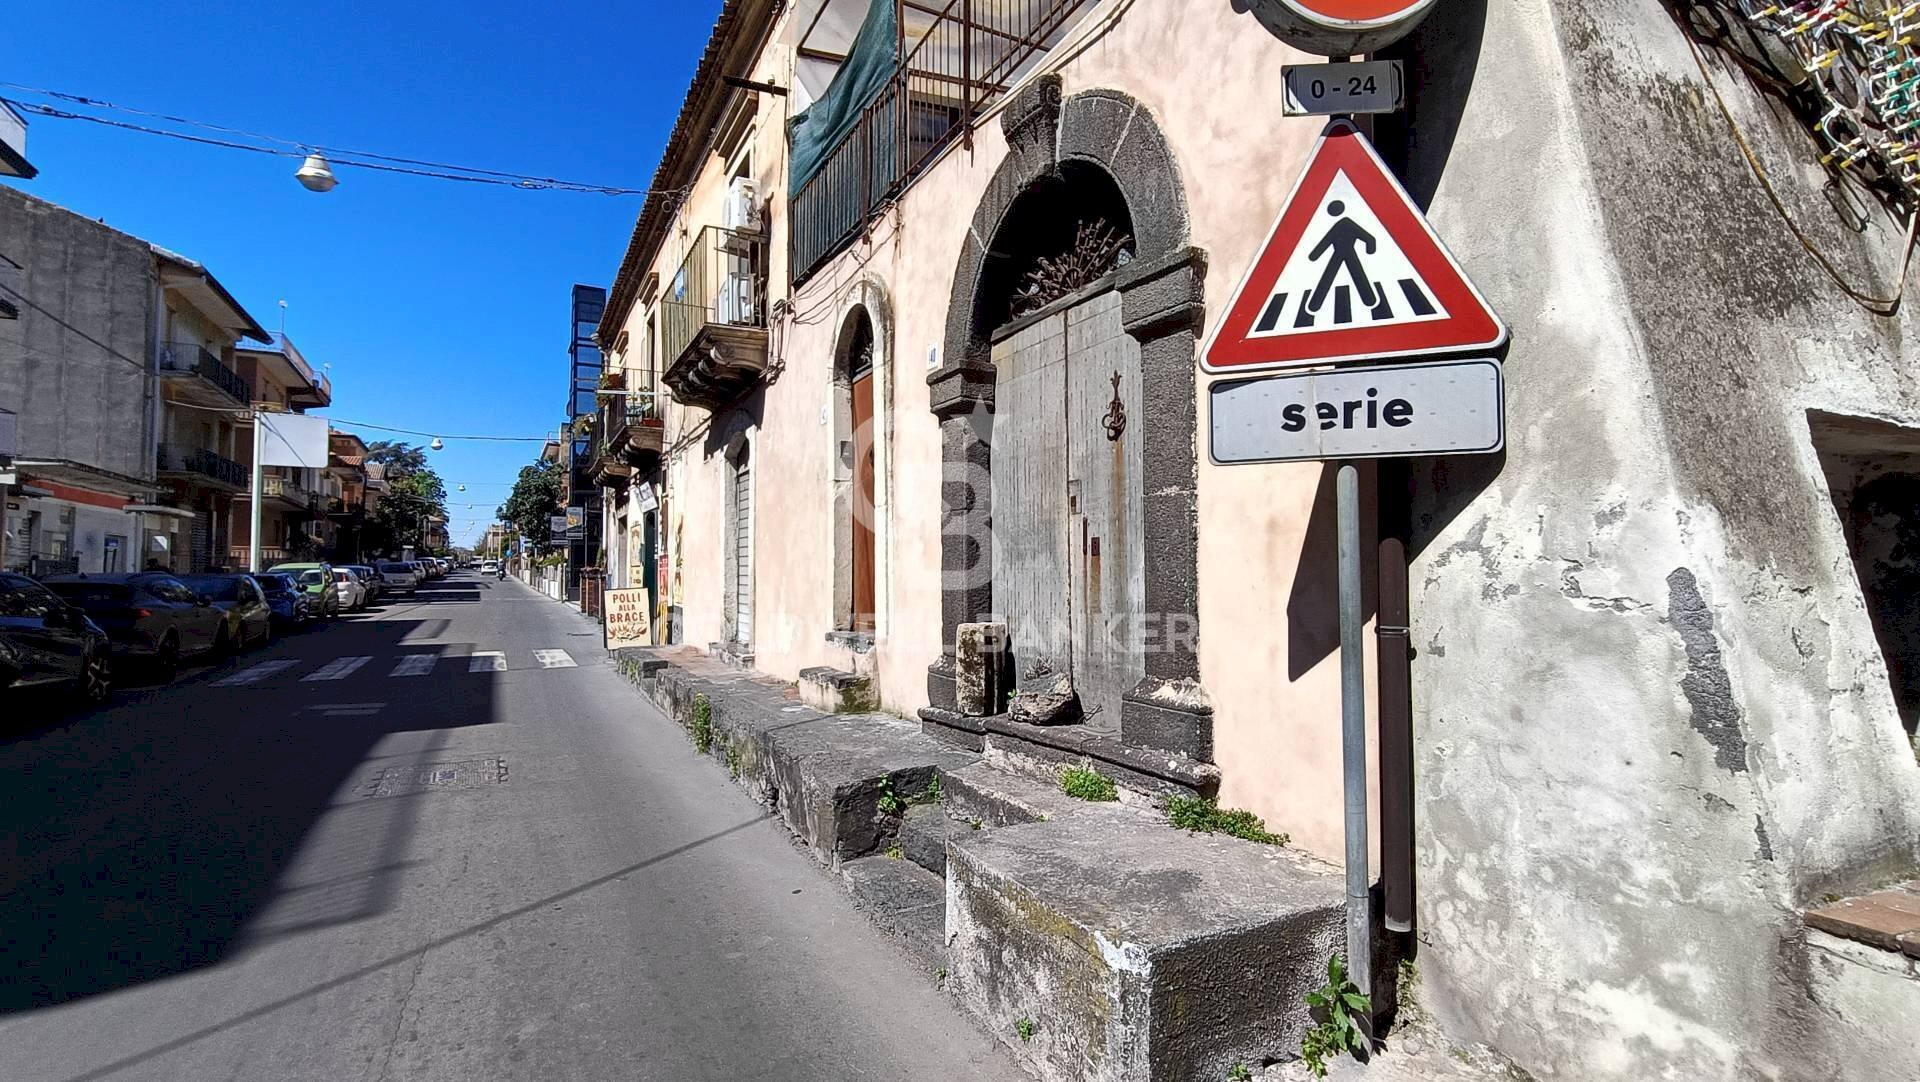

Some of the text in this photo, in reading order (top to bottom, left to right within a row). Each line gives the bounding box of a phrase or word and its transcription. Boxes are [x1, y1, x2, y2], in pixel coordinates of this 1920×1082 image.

[1311, 79, 1325, 99] 0
[1348, 75, 1377, 96] 24
[1280, 387, 1414, 432] serie
[612, 593, 641, 604] POLLI
[609, 611, 645, 623] BRACE
